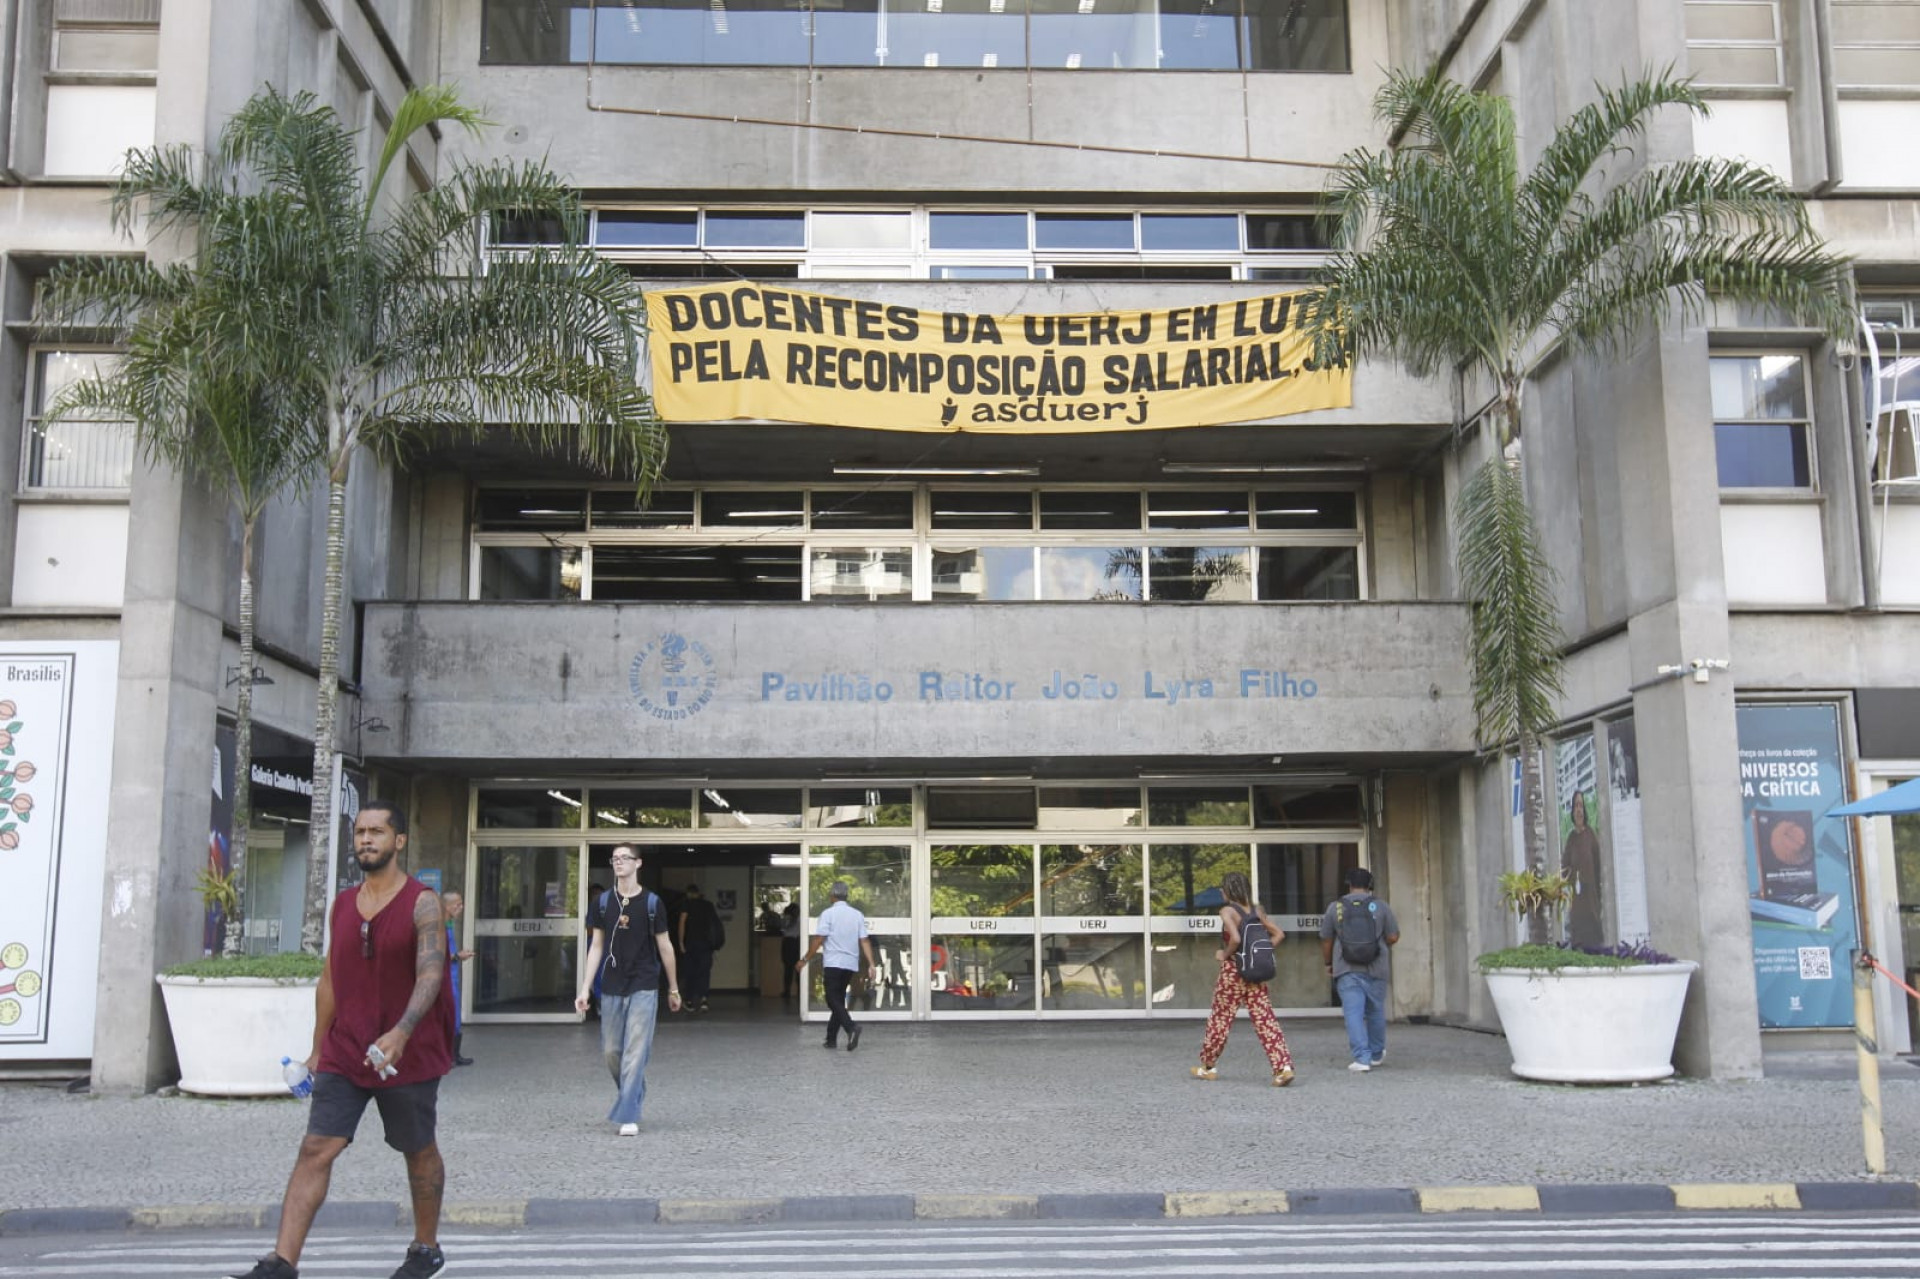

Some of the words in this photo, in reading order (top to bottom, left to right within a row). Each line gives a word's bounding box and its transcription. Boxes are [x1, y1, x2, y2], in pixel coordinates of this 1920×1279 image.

[664, 287, 919, 342] DOCENTES
[942, 311, 1003, 345] DA
[1024, 312, 1152, 346] UERJ
[1167, 304, 1219, 342] EM
[670, 339, 770, 384] PELA
[787, 342, 1086, 402] RECOMPOSIÇÃO
[1103, 341, 1299, 395] SALARIAL,
[971, 394, 1150, 426] asduerj
[7, 664, 61, 682] Brasilis
[761, 671, 893, 702] Pavilhão
[918, 671, 1017, 701] Reitor
[1042, 670, 1119, 700] João
[1144, 671, 1213, 705] Lyra
[1239, 669, 1318, 698] Filho
[1740, 762, 1819, 778] NIVERSOS
[1759, 778, 1822, 797] CRÍTICA
[513, 922, 541, 932] UERJ
[970, 920, 997, 930] UERJ
[1080, 919, 1107, 929] UERJ
[1188, 918, 1215, 928] UERJ
